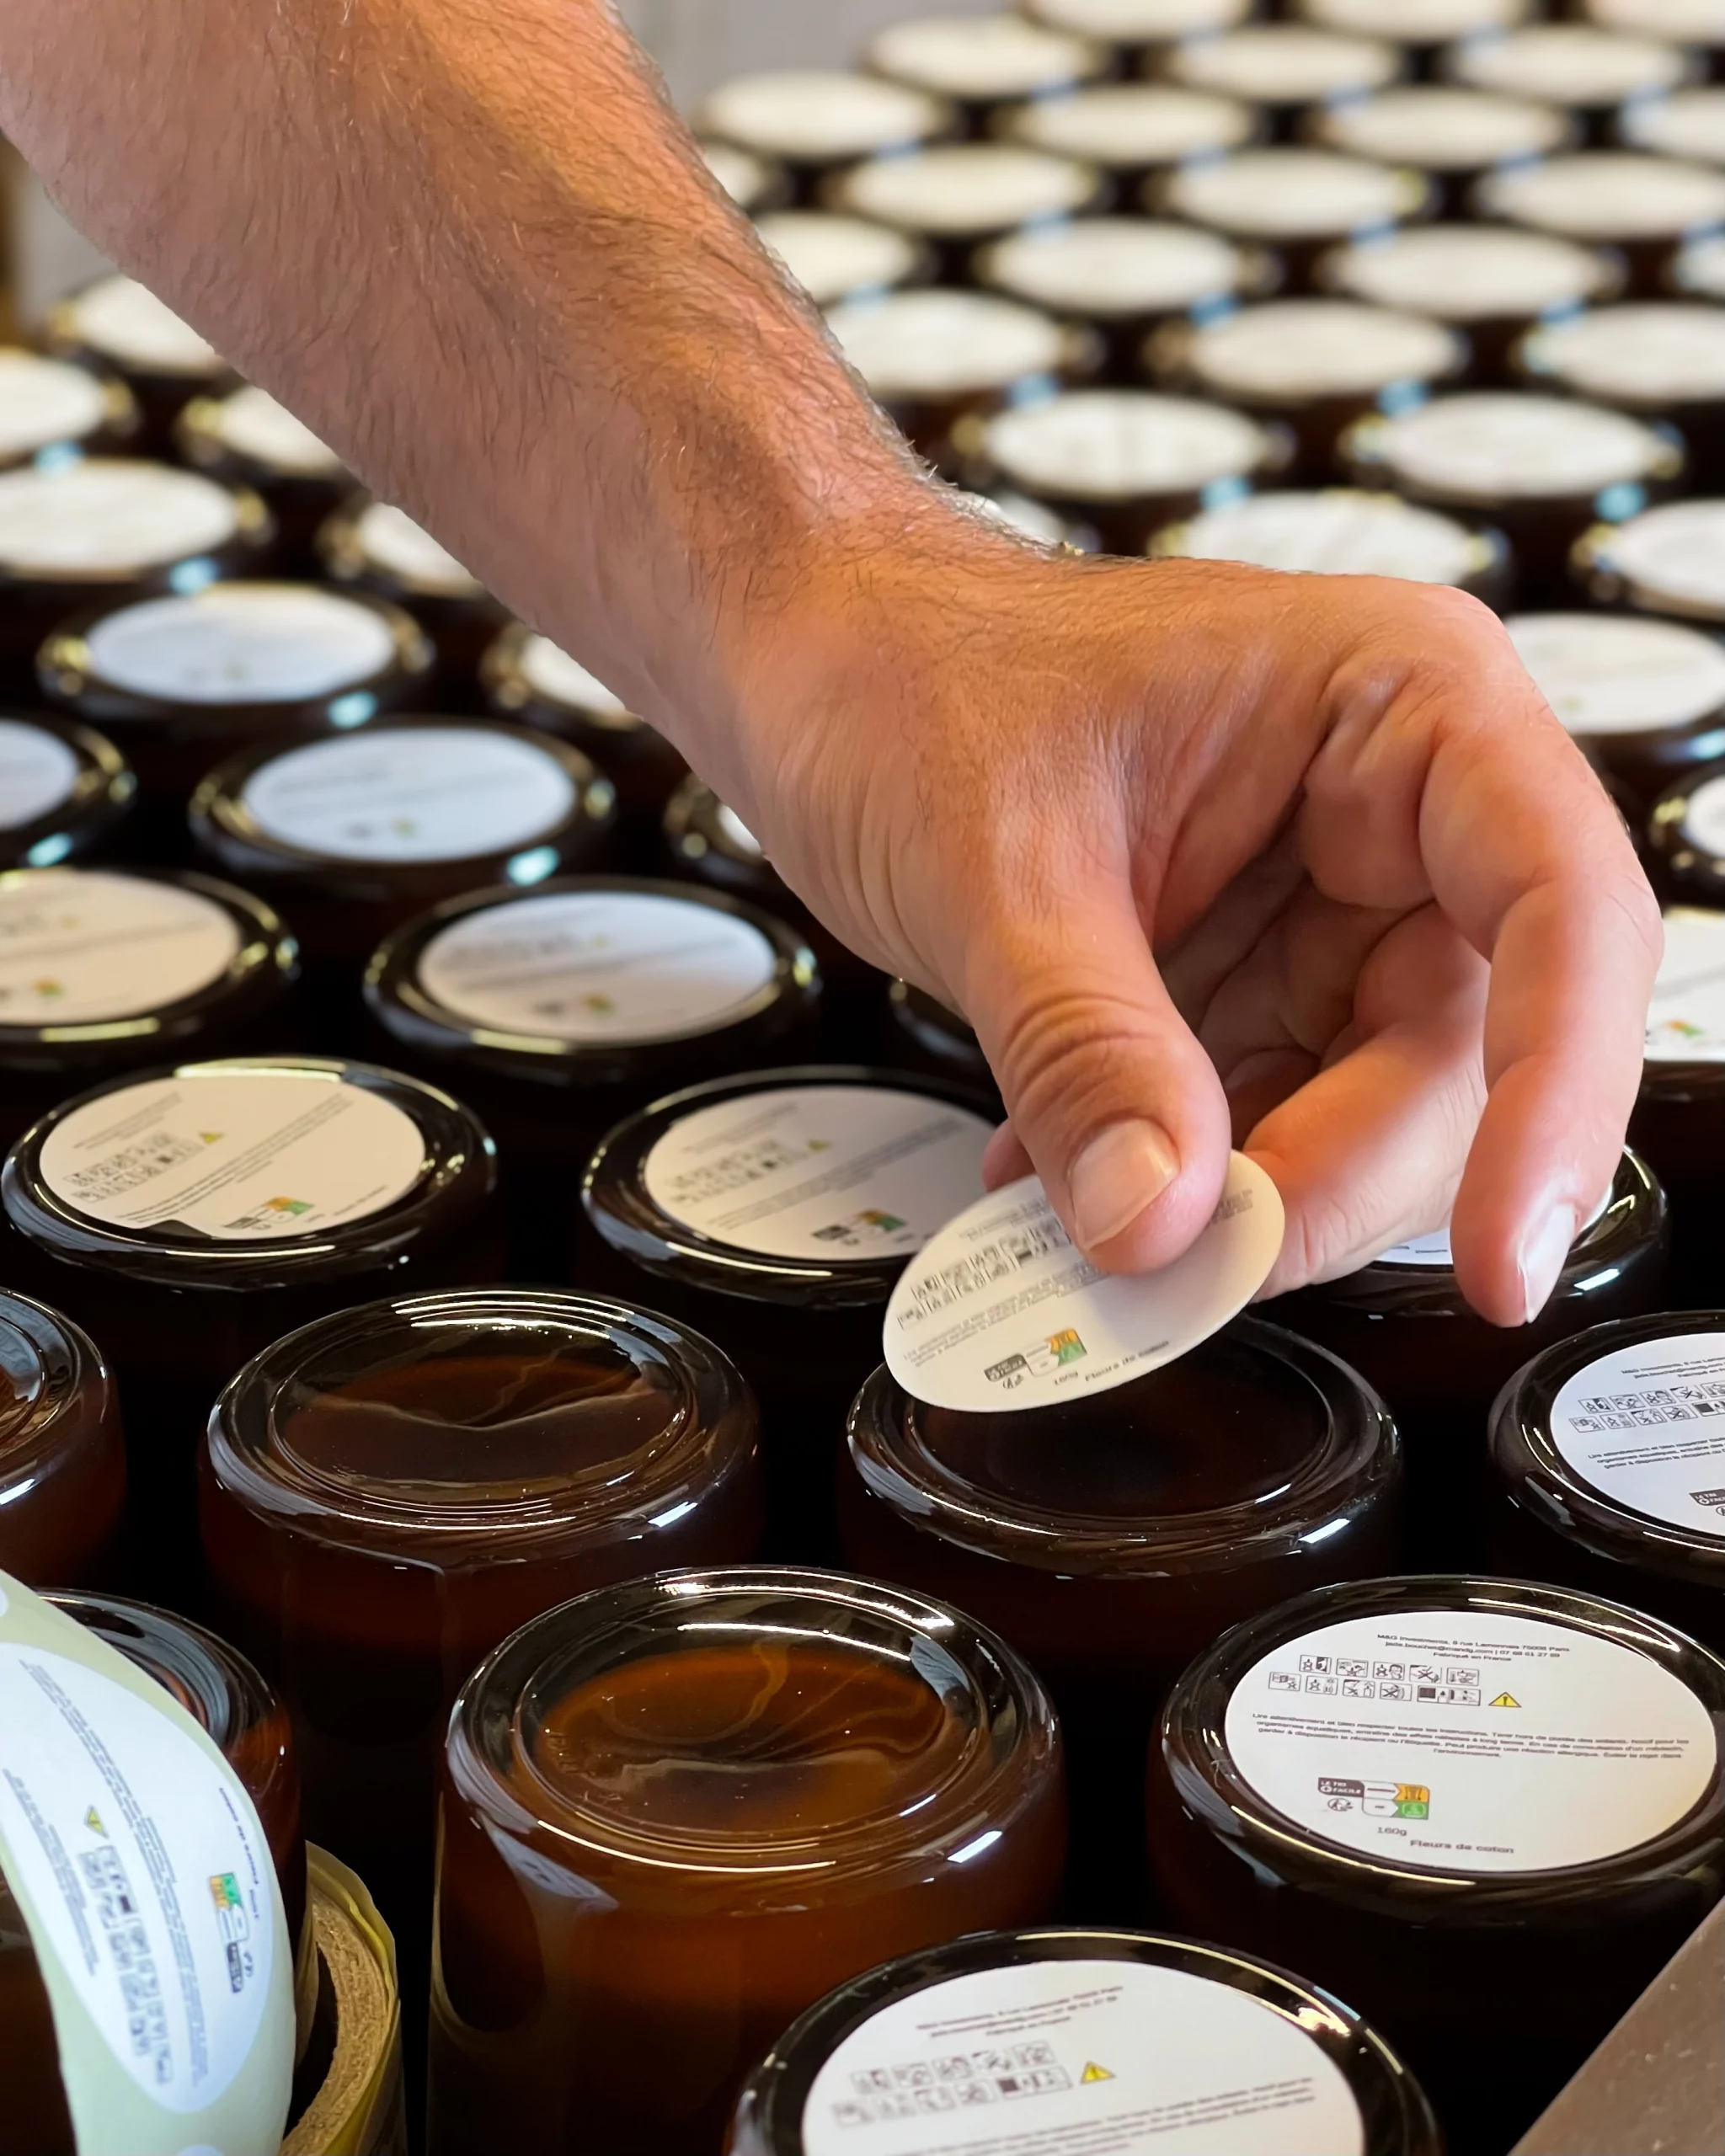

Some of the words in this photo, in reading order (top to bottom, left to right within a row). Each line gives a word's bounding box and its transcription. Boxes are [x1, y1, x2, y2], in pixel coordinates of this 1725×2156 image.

[1377, 1827, 1407, 1837] 160g
[1410, 1839, 1451, 1849] Fleurs
[1476, 1845, 1514, 1854] coton
